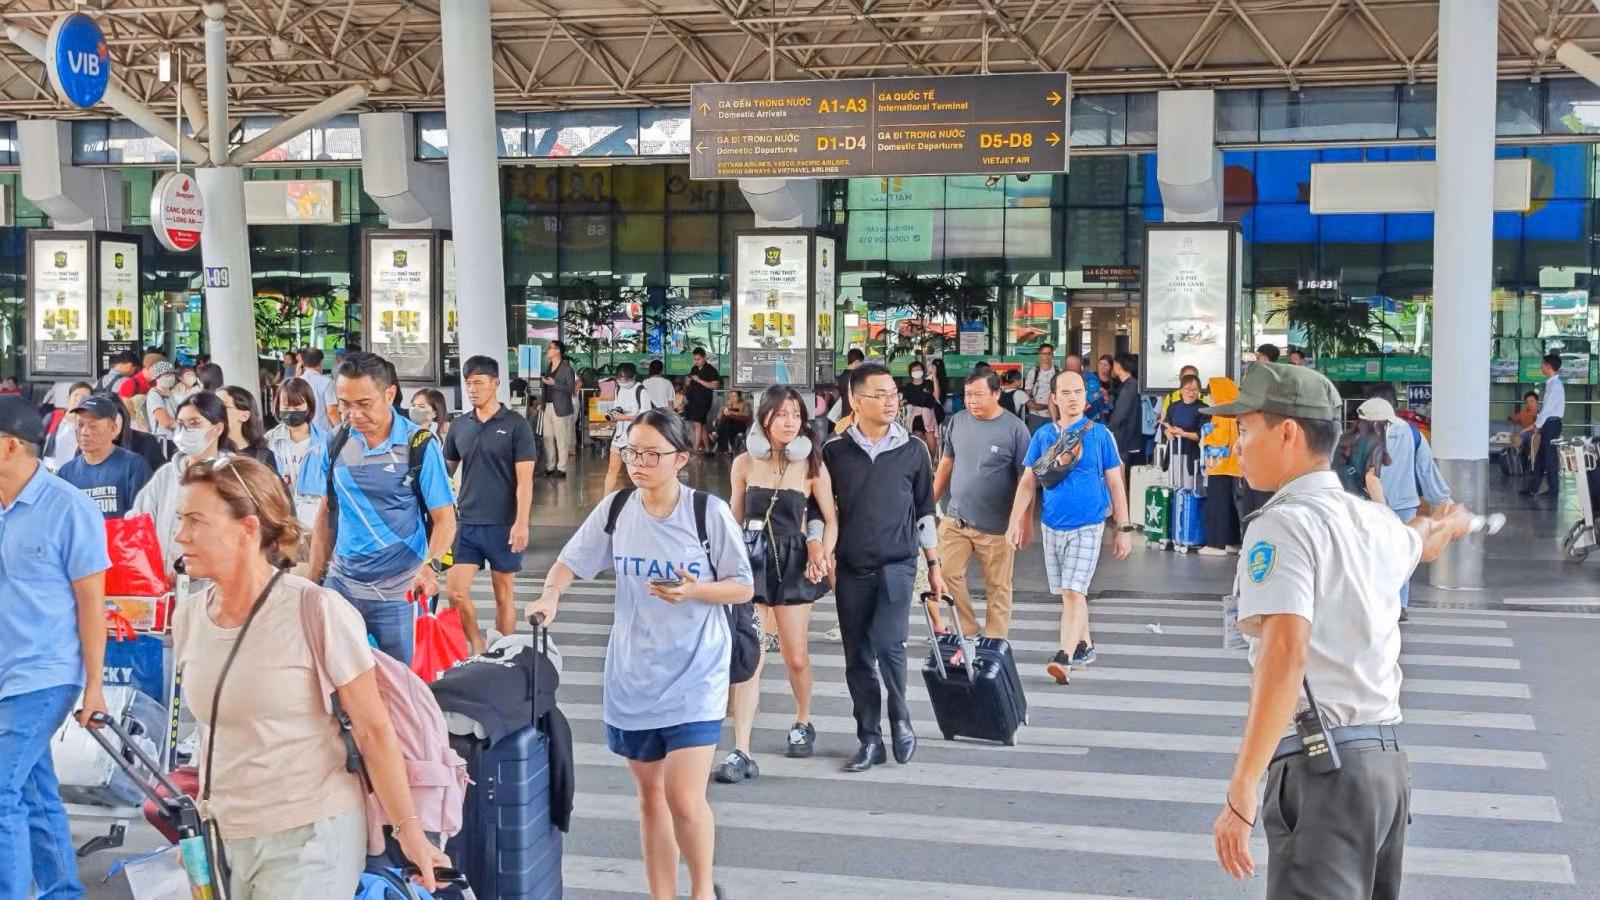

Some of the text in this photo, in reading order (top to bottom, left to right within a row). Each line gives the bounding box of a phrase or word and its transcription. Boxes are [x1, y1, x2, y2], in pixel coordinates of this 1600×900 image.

[68, 50, 100, 76] VIB
[878, 89, 935, 101] GA QUỐC TẾ
[718, 96, 812, 109] GA ĐẾN TRONG NƯỚC
[818, 98, 867, 114] A1-A3
[878, 102, 968, 113] International Terminal
[718, 109, 787, 119] Domestic Arrivals
[717, 132, 800, 144] GA ĐI TRONG NƯỚC
[877, 129, 966, 140] GA ĐI TRONG NƯỚC
[817, 136, 867, 151] D1-D4
[877, 142, 963, 151] Domestic Departures
[980, 133, 1033, 149] D5-D8
[717, 146, 798, 156] Domestic Departures
[982, 156, 1030, 165] VIETJET AIR
[1307, 280, 1333, 289] 16:23
[614, 556, 701, 580] TITANS
